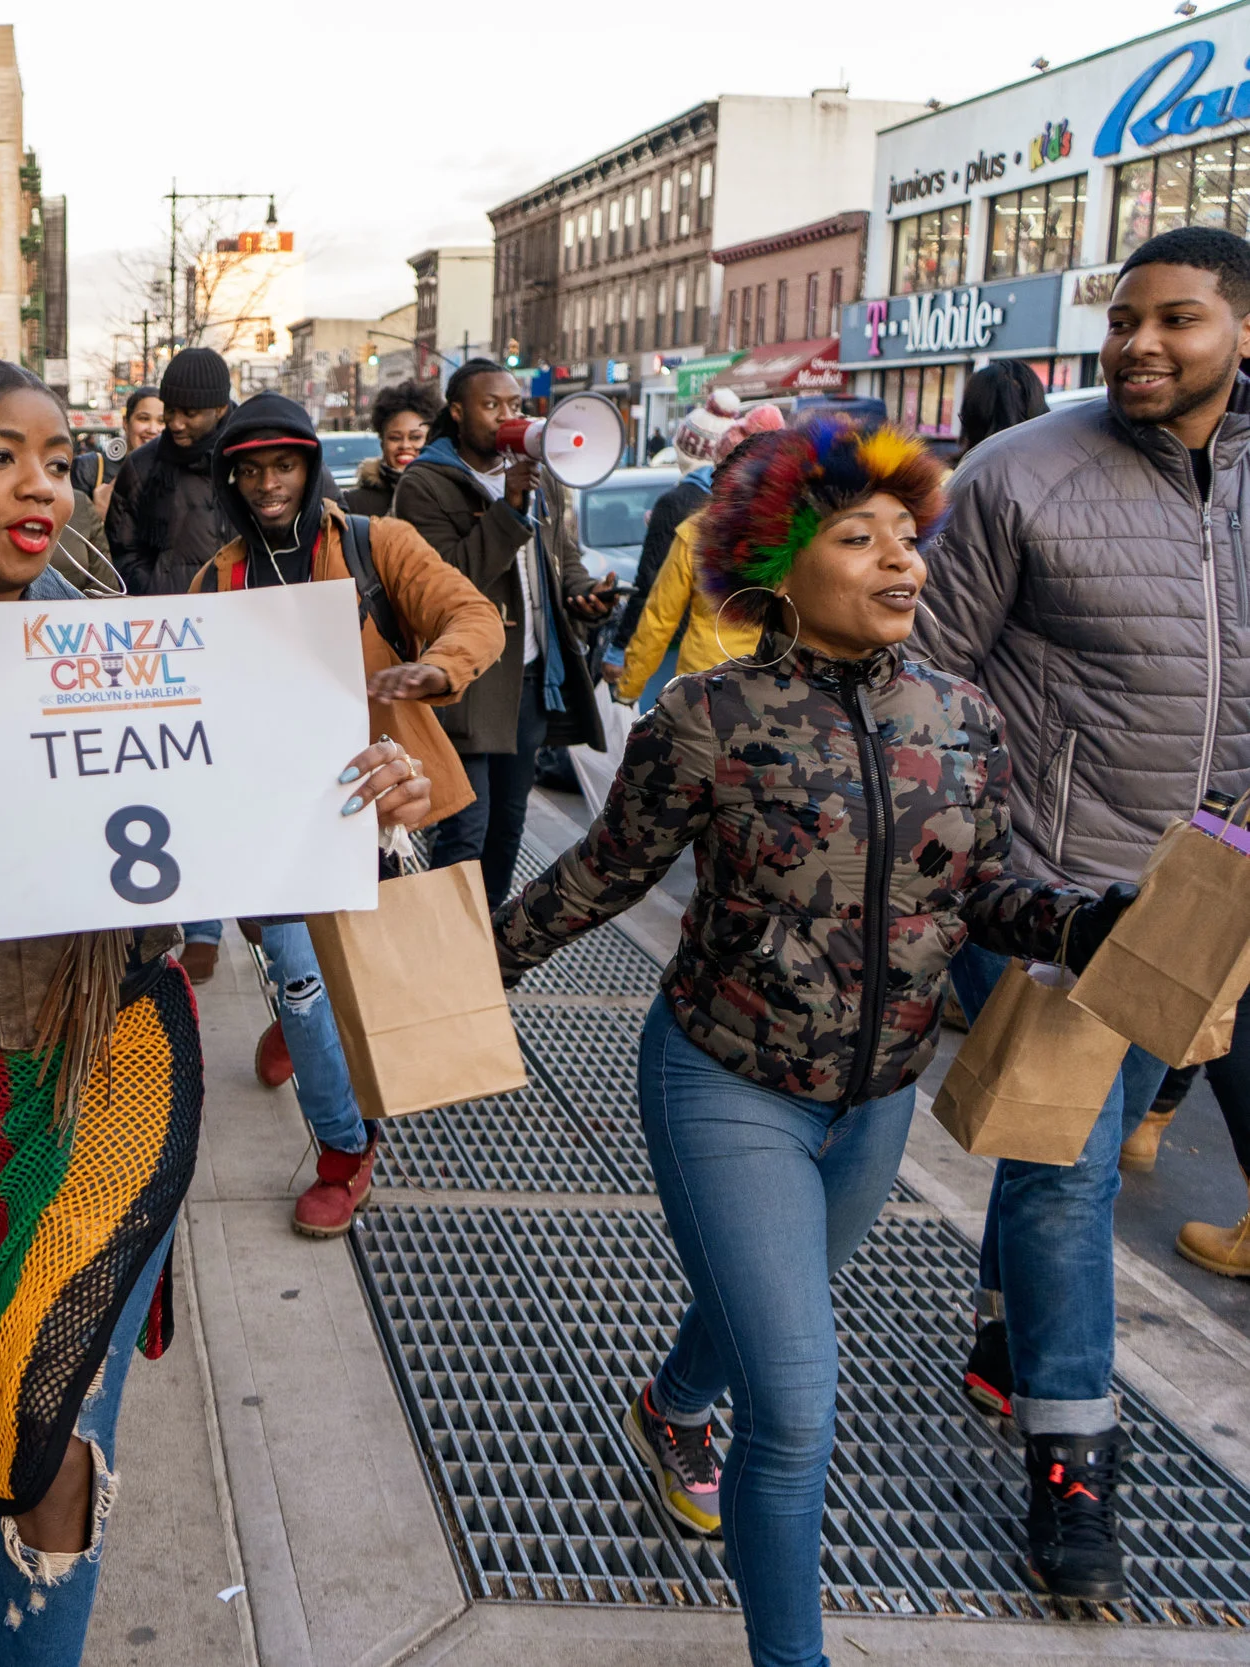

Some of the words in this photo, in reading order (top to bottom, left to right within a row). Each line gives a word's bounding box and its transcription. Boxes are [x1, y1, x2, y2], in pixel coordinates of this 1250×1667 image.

[886, 169, 946, 215] juniors
[964, 149, 1006, 194] plus
[51, 652, 186, 691] CRWL
[56, 690, 122, 705] BROOKLYN
[124, 691, 133, 700] &
[134, 685, 184, 700] HARLEM
[29, 720, 213, 779] TEAM
[105, 804, 181, 905] 8
